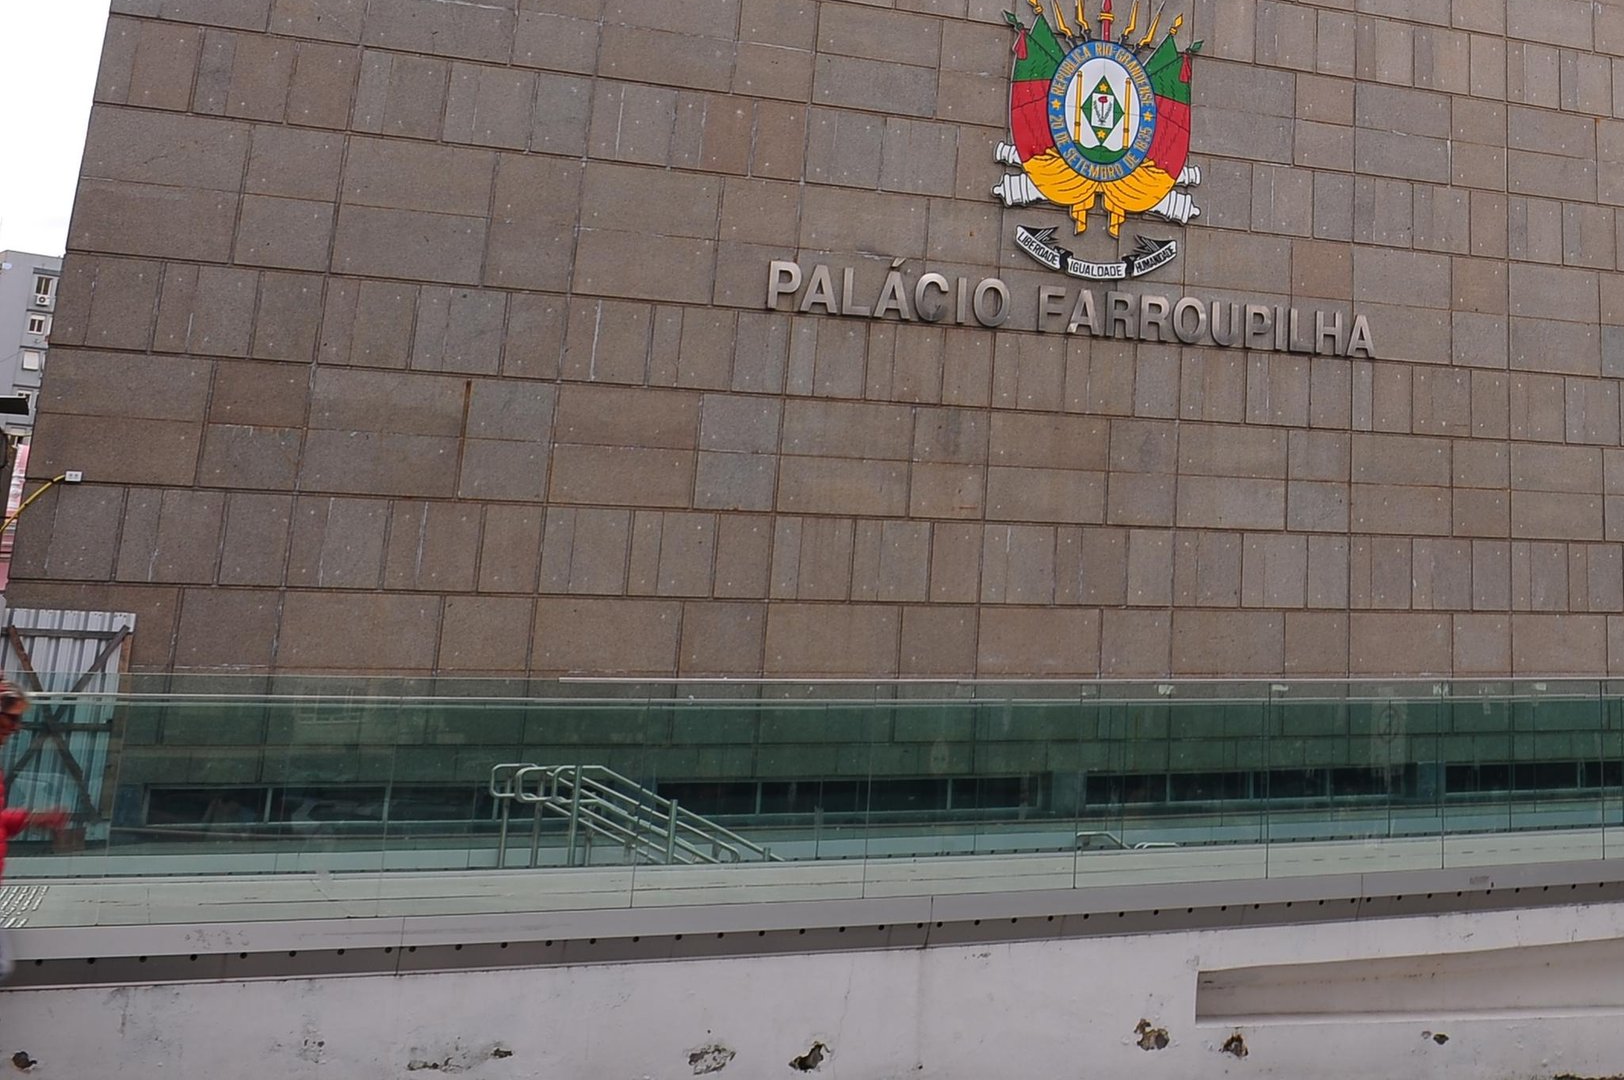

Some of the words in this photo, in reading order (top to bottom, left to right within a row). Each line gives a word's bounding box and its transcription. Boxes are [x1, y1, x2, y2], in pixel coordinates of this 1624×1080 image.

[1063, 147, 1124, 179] SETEMBRO
[1017, 231, 1059, 266] LIBERDADE
[1069, 260, 1123, 277] IGUALDADE
[766, 257, 1011, 327] PALÁCIO
[1036, 284, 1376, 358] FARROUPILHA
